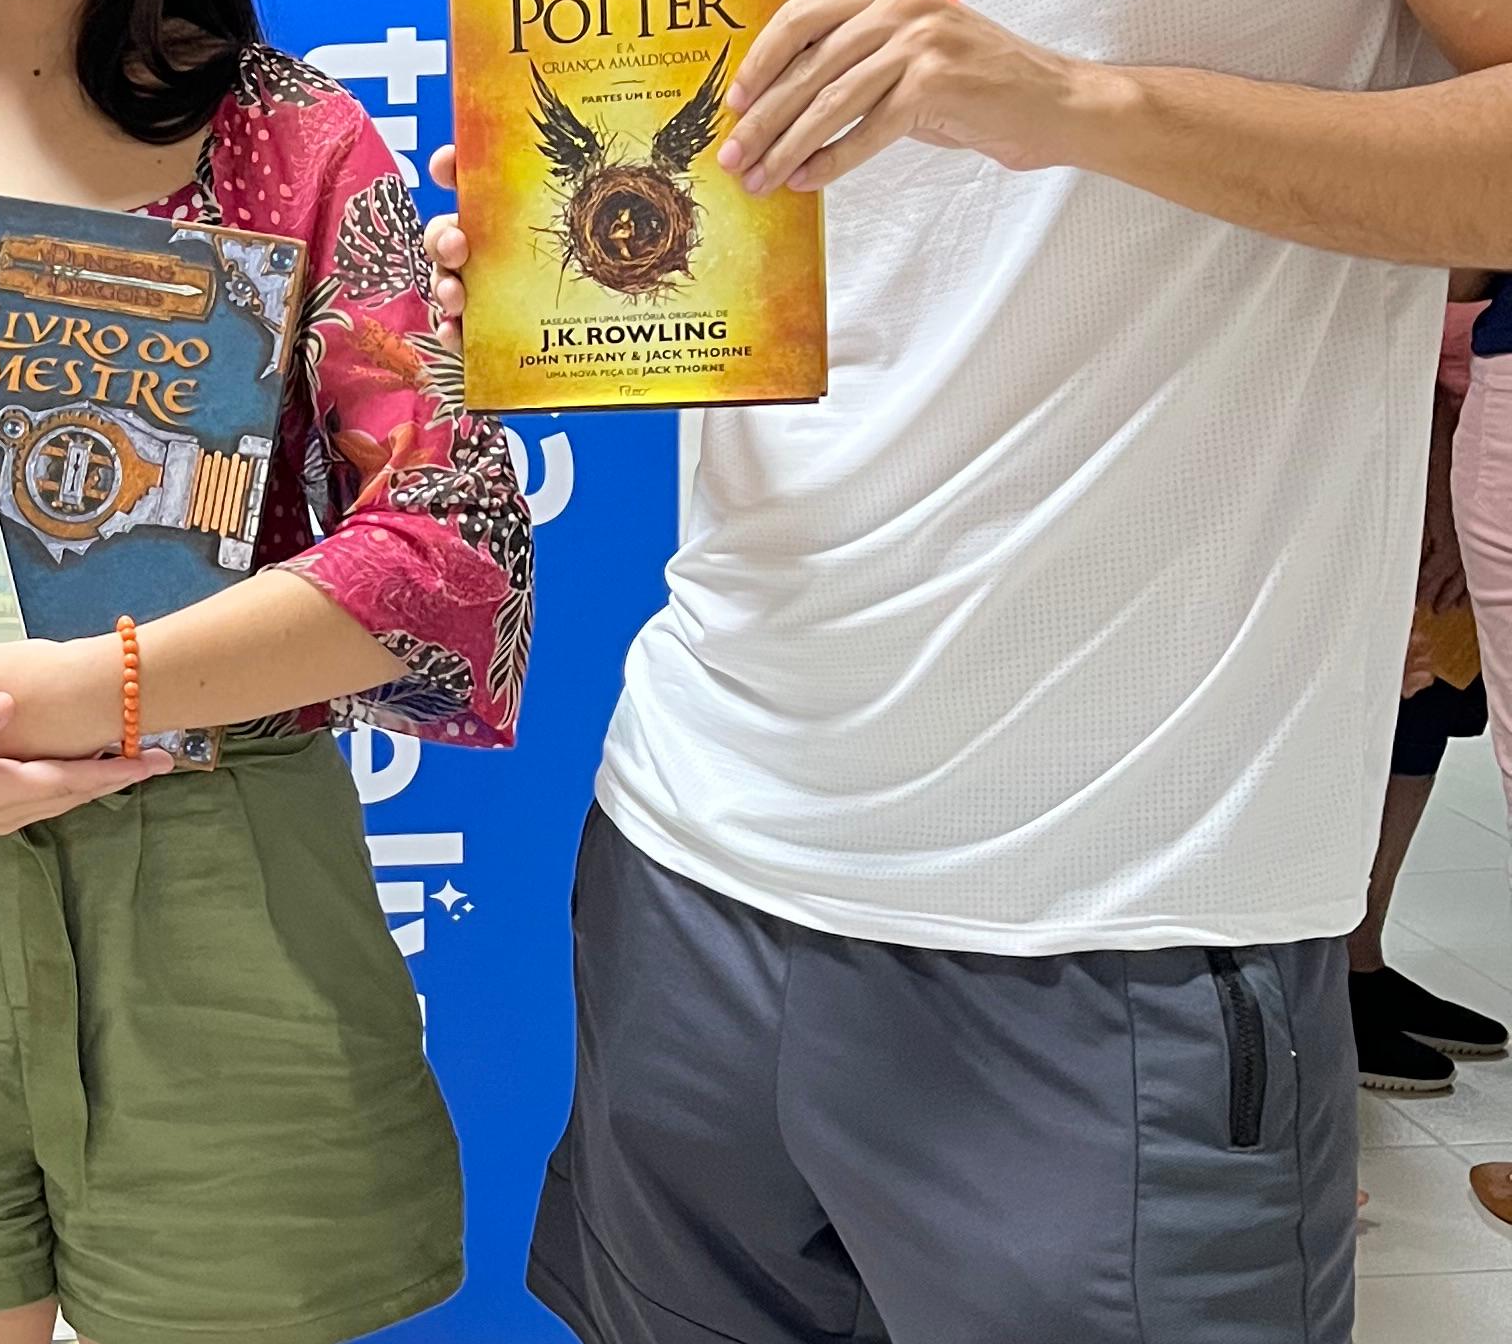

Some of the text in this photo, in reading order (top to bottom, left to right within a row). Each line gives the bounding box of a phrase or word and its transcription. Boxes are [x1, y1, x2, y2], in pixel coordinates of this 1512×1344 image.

[541, 49, 712, 76] CRIANÇA AMALDIÇOADA
[581, 88, 682, 105] PARTES UM E DOIS
[715, 309, 729, 318] DE
[541, 320, 727, 353] J.K. ROWLING
[520, 345, 753, 369] JOHN TIFFANY & JACK THORNE
[626, 367, 639, 376] DE
[642, 364, 671, 376] JACK
[675, 362, 725, 373] THORNE
